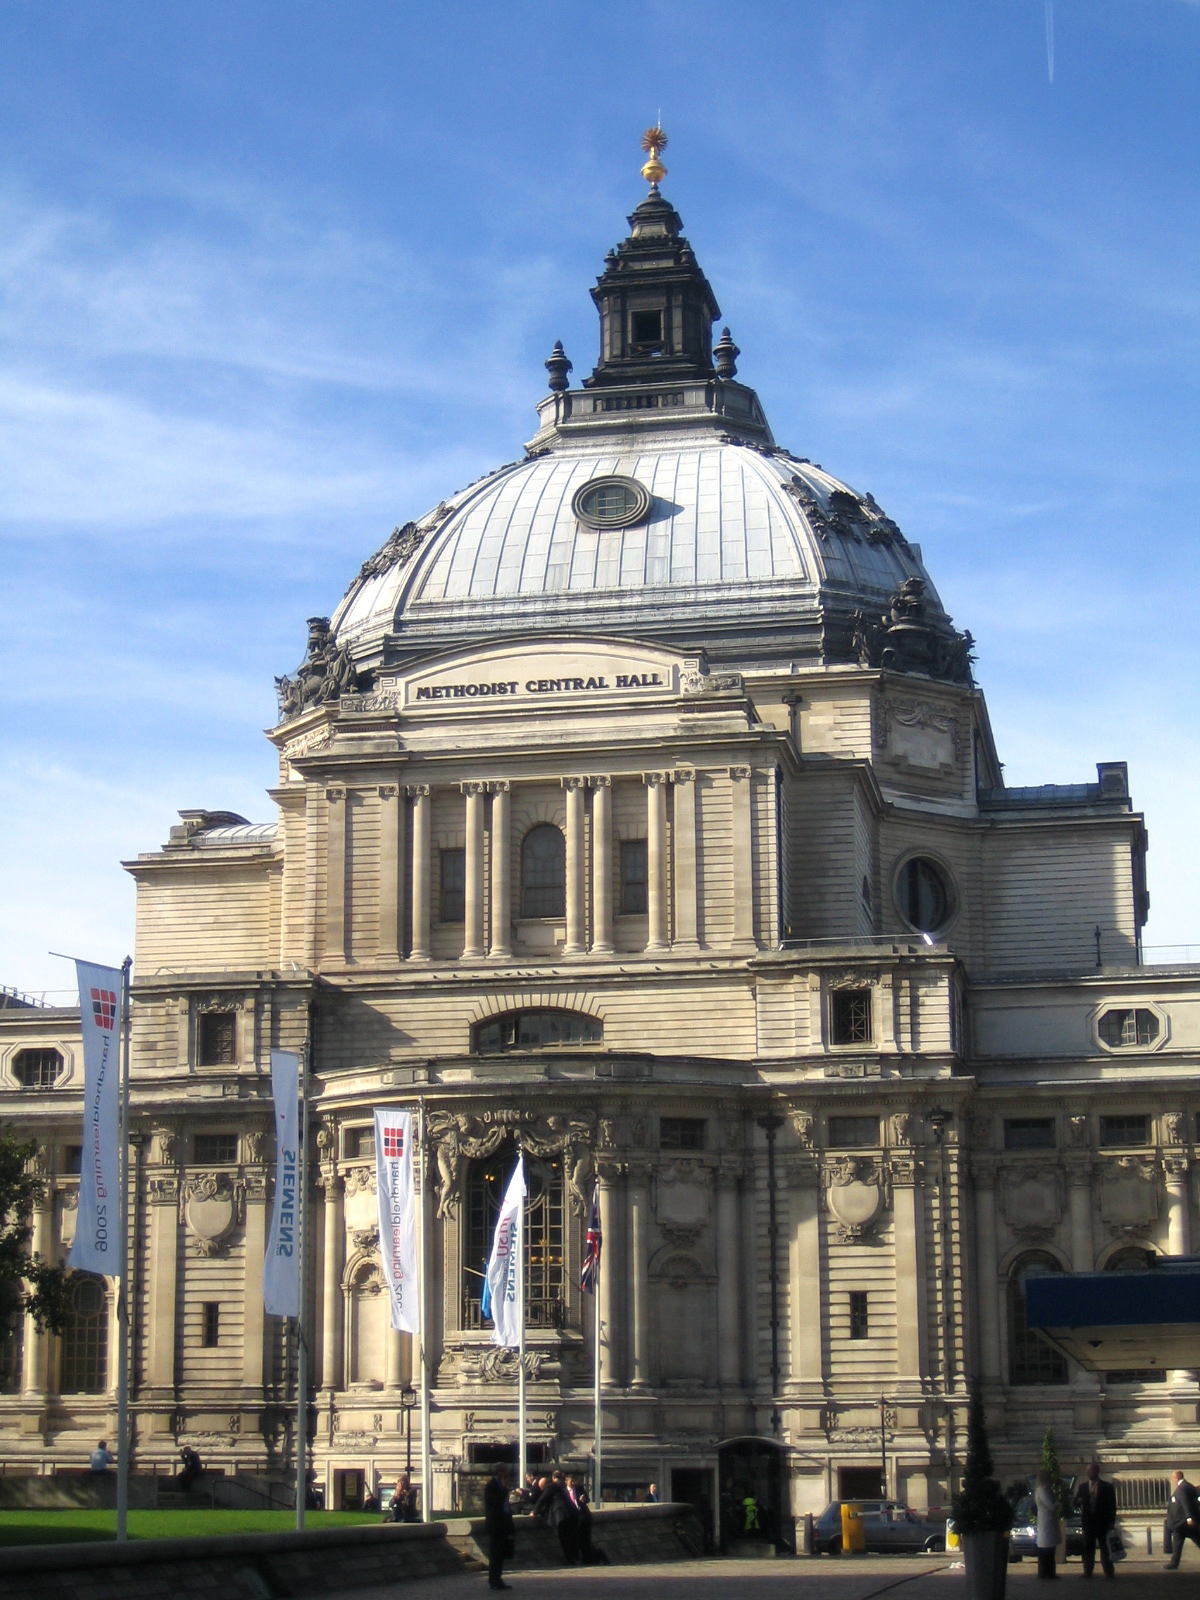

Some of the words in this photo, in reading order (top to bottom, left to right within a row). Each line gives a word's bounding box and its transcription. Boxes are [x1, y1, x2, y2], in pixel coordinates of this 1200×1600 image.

[416, 681, 518, 699] METHODIST
[525, 676, 609, 693] CENTRAL
[616, 673, 662, 688] HALL
